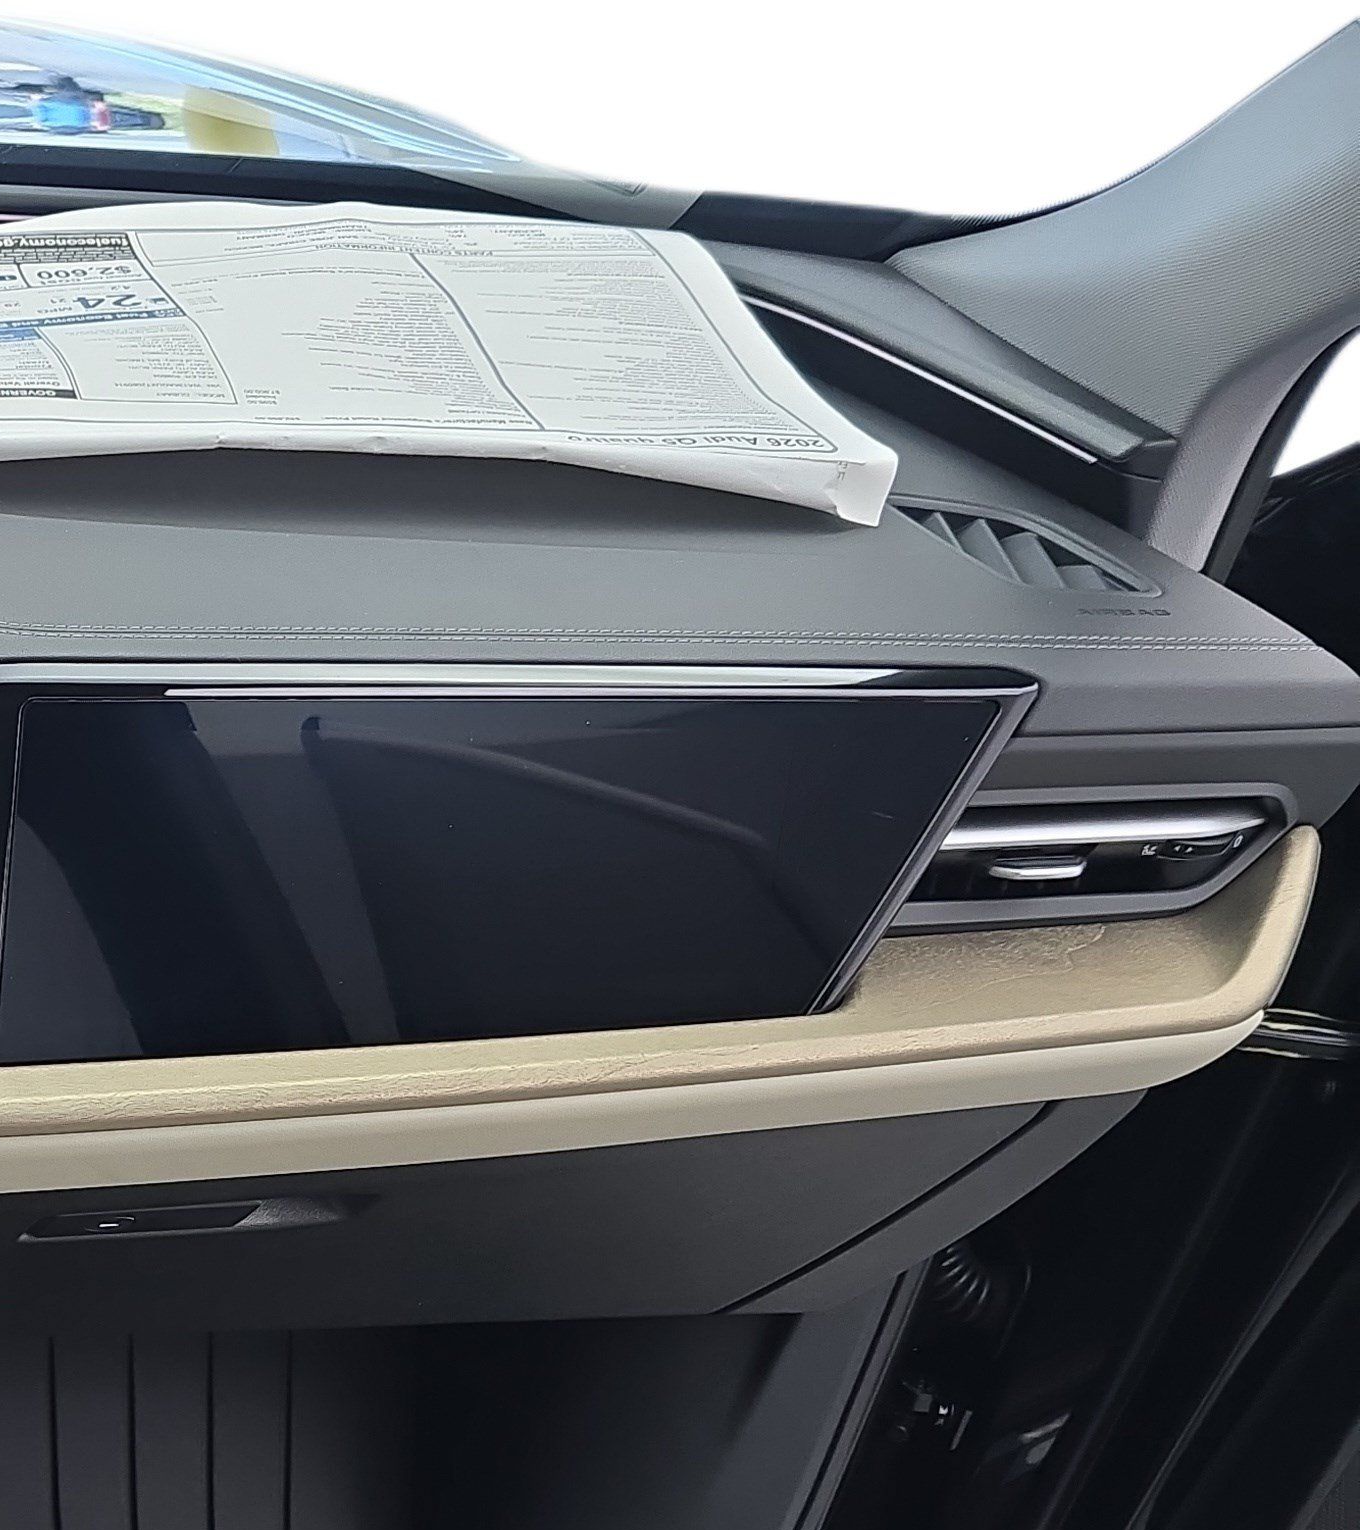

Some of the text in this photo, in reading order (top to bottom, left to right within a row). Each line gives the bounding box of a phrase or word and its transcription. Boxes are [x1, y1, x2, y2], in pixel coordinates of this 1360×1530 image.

[37, 266, 132, 280] $2,600
[72, 294, 143, 309] 24
[43, 314, 114, 324] Economy
[566, 435, 825, 448] 2026 Audi Q5 quattro
